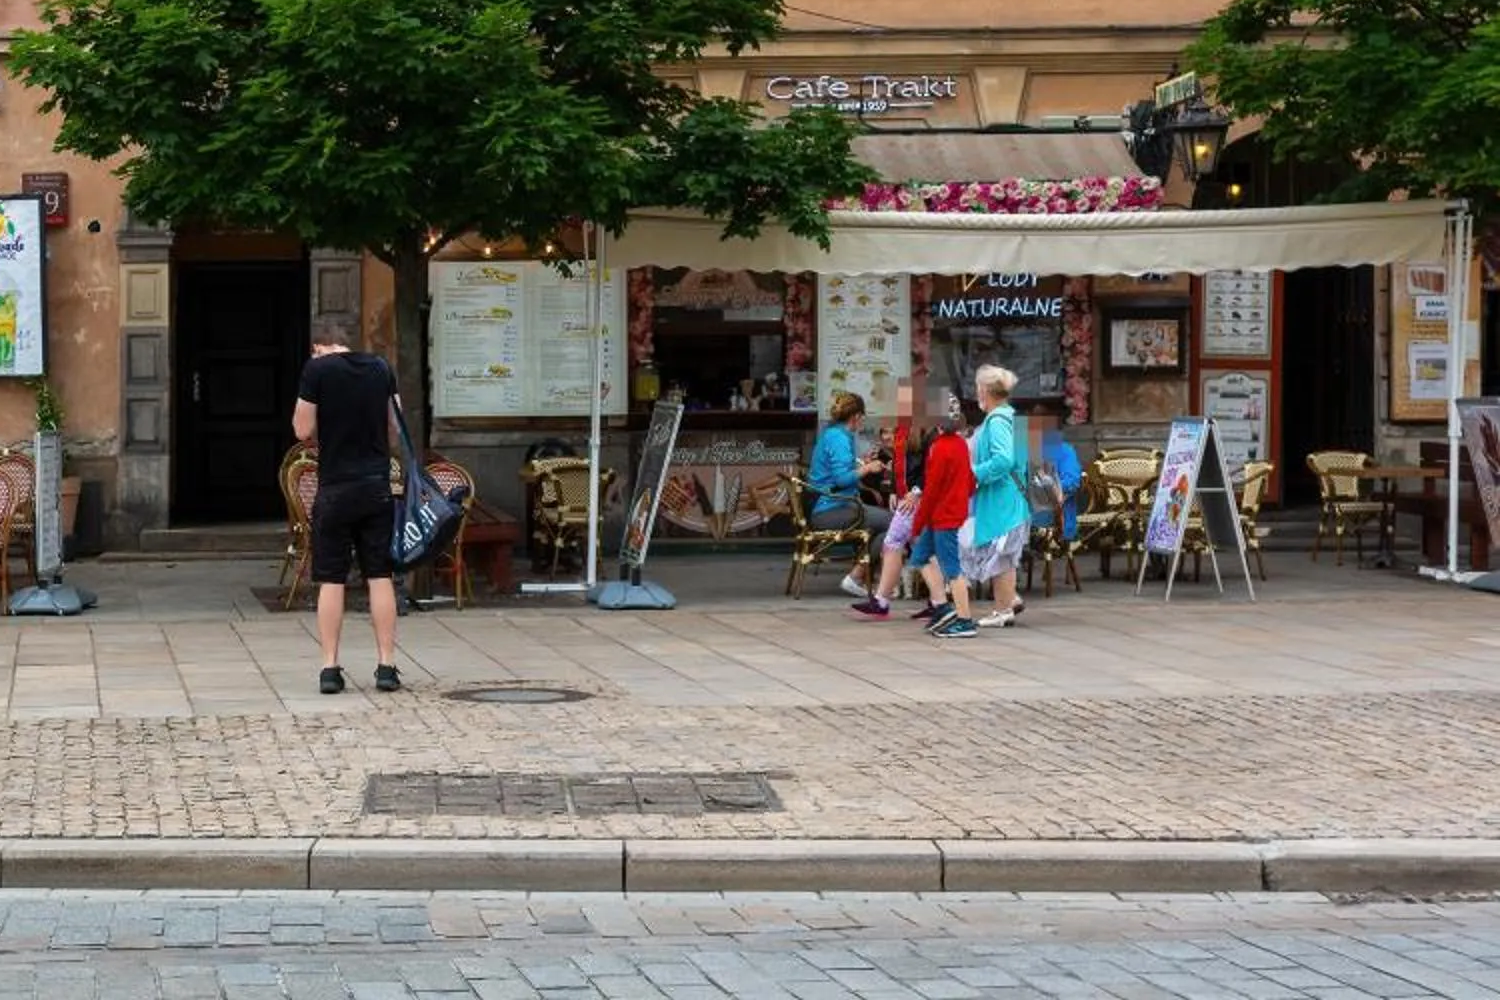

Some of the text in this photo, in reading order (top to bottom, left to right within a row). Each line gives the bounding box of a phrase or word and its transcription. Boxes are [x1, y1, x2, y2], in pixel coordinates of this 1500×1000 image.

[767, 75, 957, 99] Cafe Trakt
[938, 297, 1062, 318] NATURALNE
